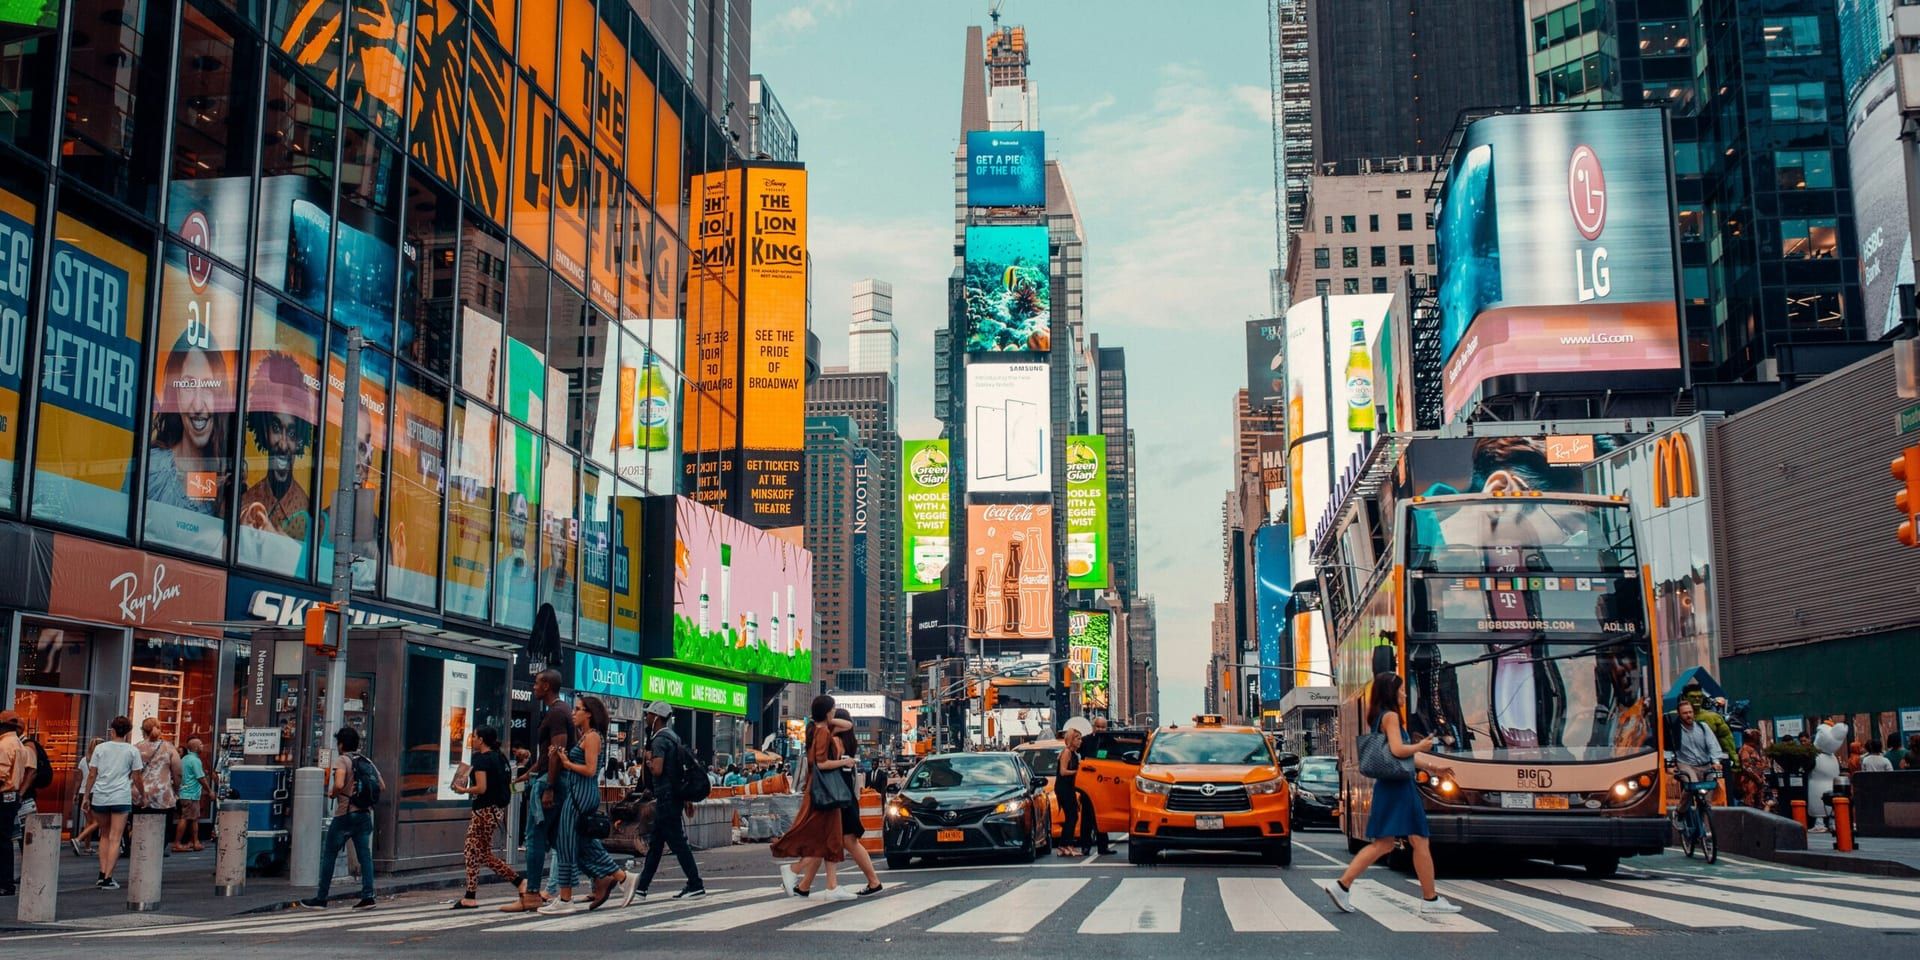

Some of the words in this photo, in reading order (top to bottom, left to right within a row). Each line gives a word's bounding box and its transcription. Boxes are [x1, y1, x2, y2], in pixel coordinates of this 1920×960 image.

[581, 47, 624, 146] THE
[976, 155, 994, 165] GET
[996, 155, 1003, 165] A
[1005, 155, 1025, 165] PIEC
[976, 166, 987, 175] OF
[990, 166, 1008, 175] THE
[1010, 166, 1022, 175] RO
[764, 178, 787, 188] Disney
[760, 194, 790, 208] THE
[755, 211, 796, 236] LION
[1863, 226, 1884, 263] HSBC
[752, 237, 802, 266] KING
[555, 248, 585, 281] ENTRANCE
[1575, 246, 1611, 302] LG
[755, 330, 775, 341] SEE
[777, 330, 794, 342] THE
[1560, 333, 1633, 345] www.LG.com
[760, 346, 789, 357] PRIDE
[768, 361, 780, 373] OF
[749, 377, 799, 389] BROADWAY
[747, 460, 763, 471] GET
[765, 460, 799, 472] TICKETS
[916, 466, 947, 475] Green
[758, 474, 769, 485] AT
[770, 474, 787, 485] THE
[1067, 470, 1096, 479] Giant
[751, 488, 794, 499] MINSKOFF
[854, 459, 867, 534] NOVOTEL
[753, 502, 791, 514] THEATRE
[1088, 499, 1096, 507] A
[914, 512, 947, 520] VEGGIE
[983, 504, 1034, 521] Coca-Cola
[1068, 508, 1096, 516] EGGIE
[917, 521, 944, 529] TWIST
[110, 564, 181, 623] Ray-Ban
[1477, 620, 1575, 630] BIGBUSTOURS.COM
[1603, 622, 1623, 632] ADL
[255, 650, 267, 706] Newsstand
[649, 675, 665, 693] NEW
[665, 678, 684, 698] YORK
[691, 683, 705, 700] LINE
[705, 684, 727, 704] FRIENDS
[732, 692, 745, 708] NEW
[1307, 692, 1331, 702] Disney
[1517, 768, 1537, 779] BIG
[1517, 779, 1537, 789] BUS
